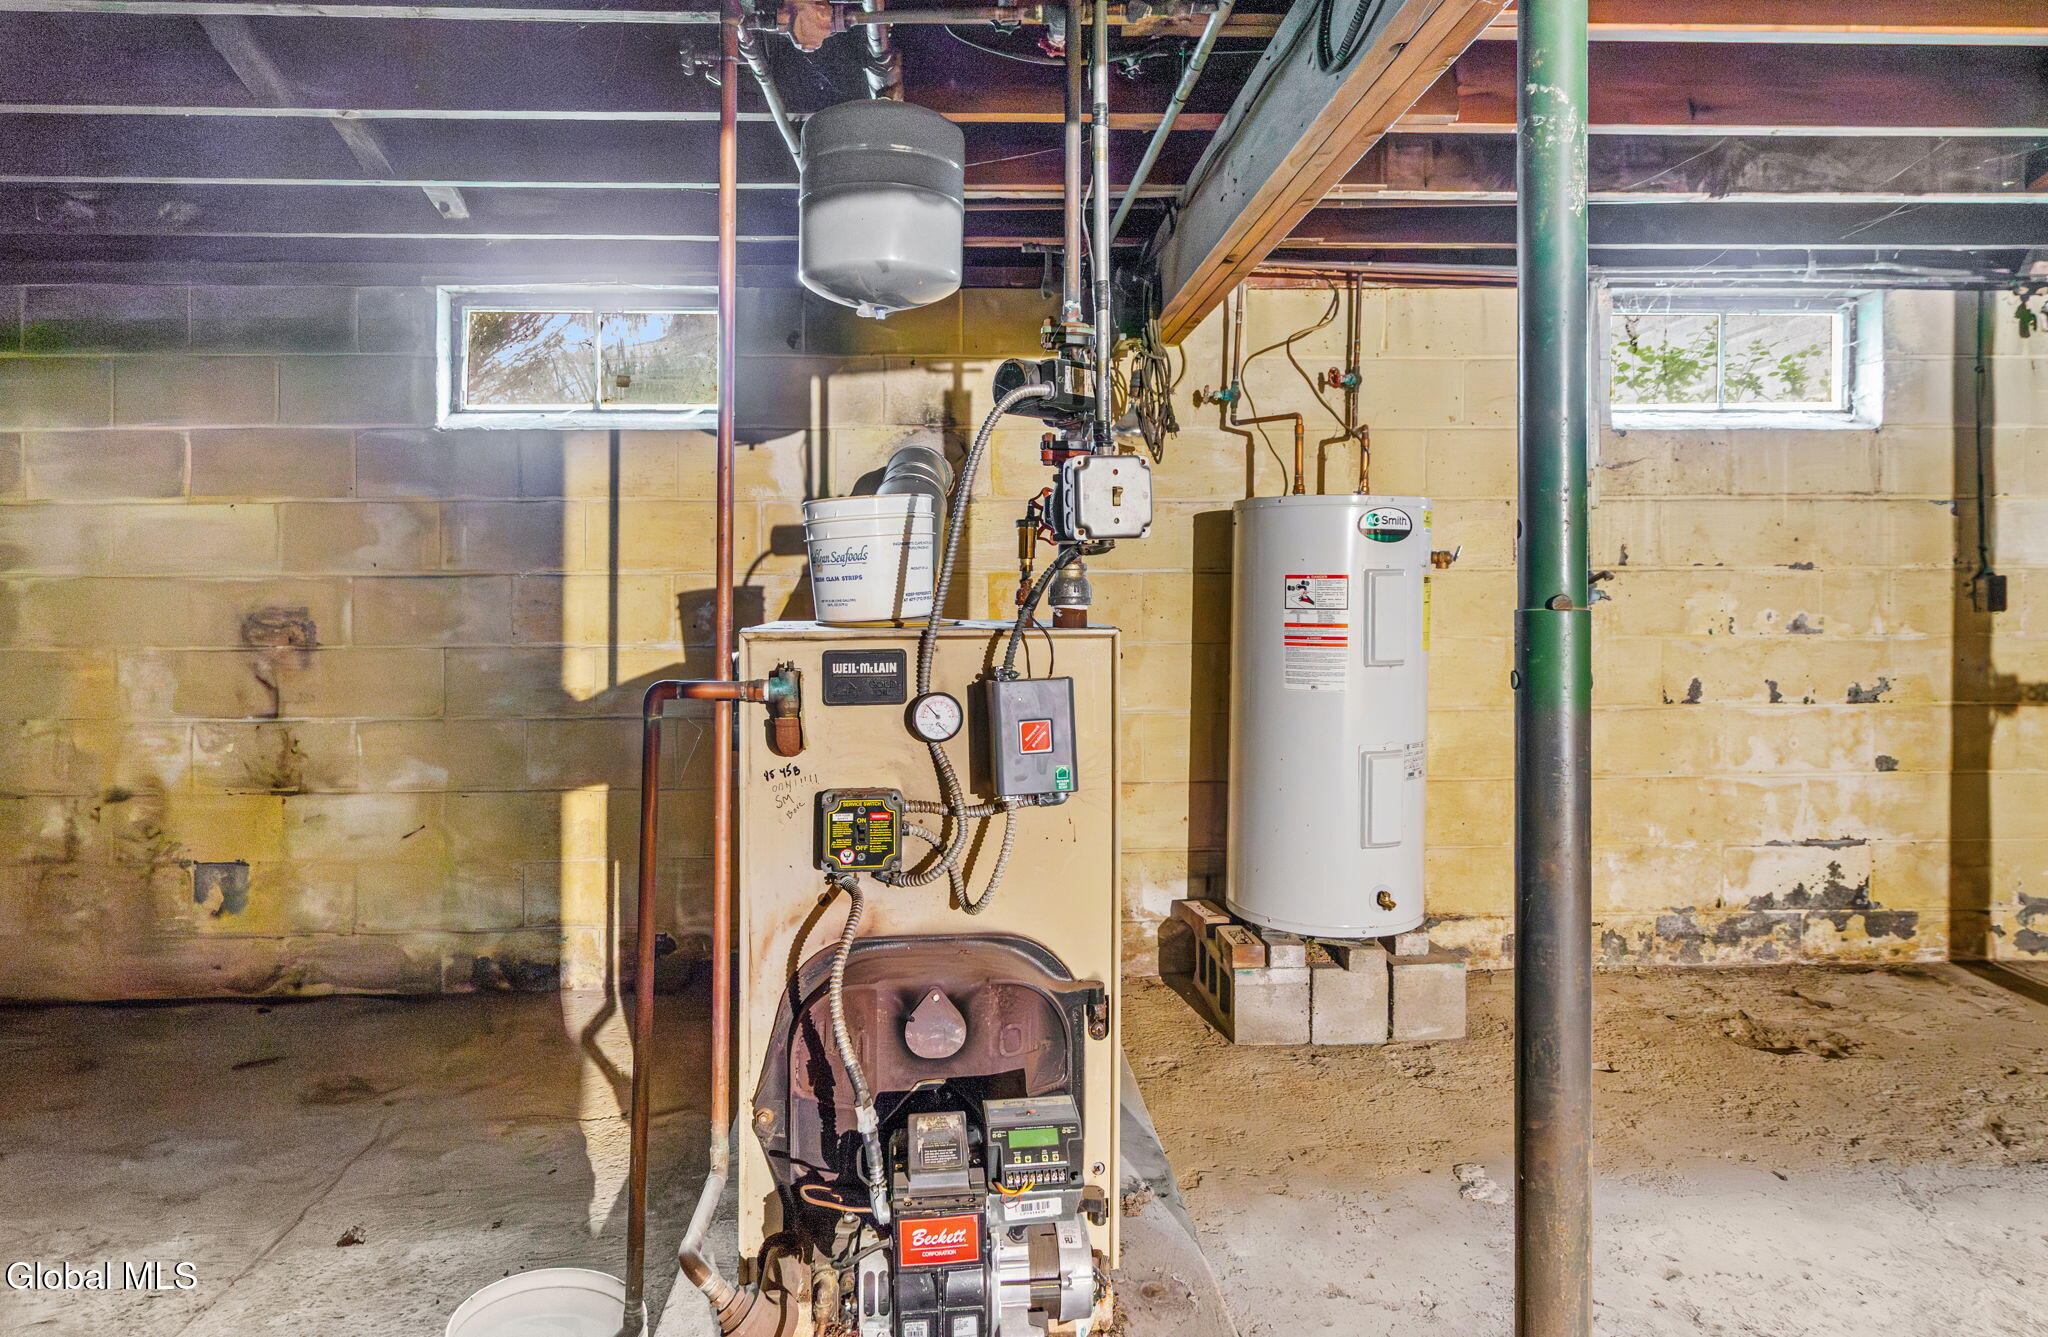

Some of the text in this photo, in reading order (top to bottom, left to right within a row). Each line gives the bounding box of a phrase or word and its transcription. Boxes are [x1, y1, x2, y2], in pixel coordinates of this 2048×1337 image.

[1381, 515, 1408, 526] Smith
[831, 544, 868, 567] Seafoods
[841, 574, 863, 582] STRIPS
[912, 1228, 966, 1247] Beckett
[922, 1249, 957, 1257] CORPORATION
